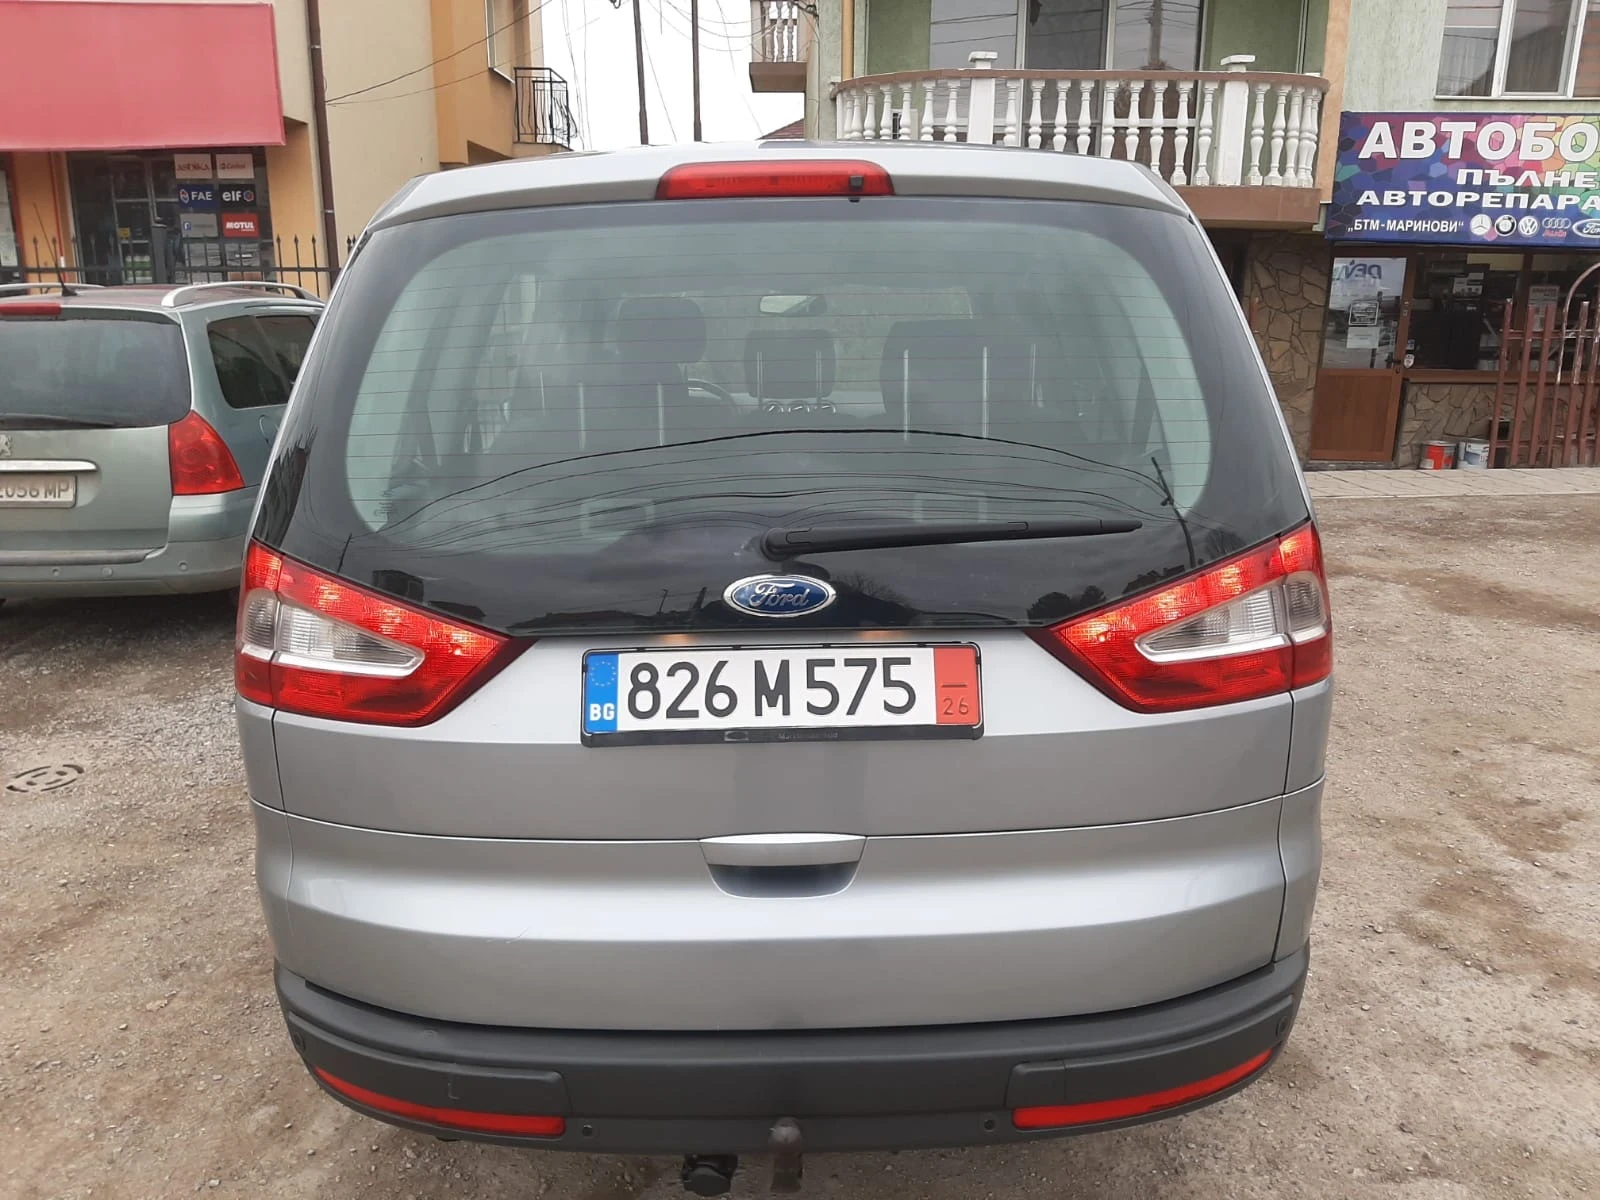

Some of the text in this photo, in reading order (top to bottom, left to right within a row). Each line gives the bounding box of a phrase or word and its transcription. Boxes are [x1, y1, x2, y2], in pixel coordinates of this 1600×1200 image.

[1358, 121, 1599, 162] АВТОБО
[1456, 169, 1598, 188] ПЪЛНЕ
[191, 191, 212, 201] FAE
[222, 190, 242, 201] elf
[1356, 190, 1600, 210] АВТОРЕПАРА
[226, 221, 254, 230] MOTUL
[749, 582, 810, 607] Ford
[628, 657, 916, 719] 826 M 575
[589, 703, 615, 721] BG
[943, 697, 970, 715] 26
